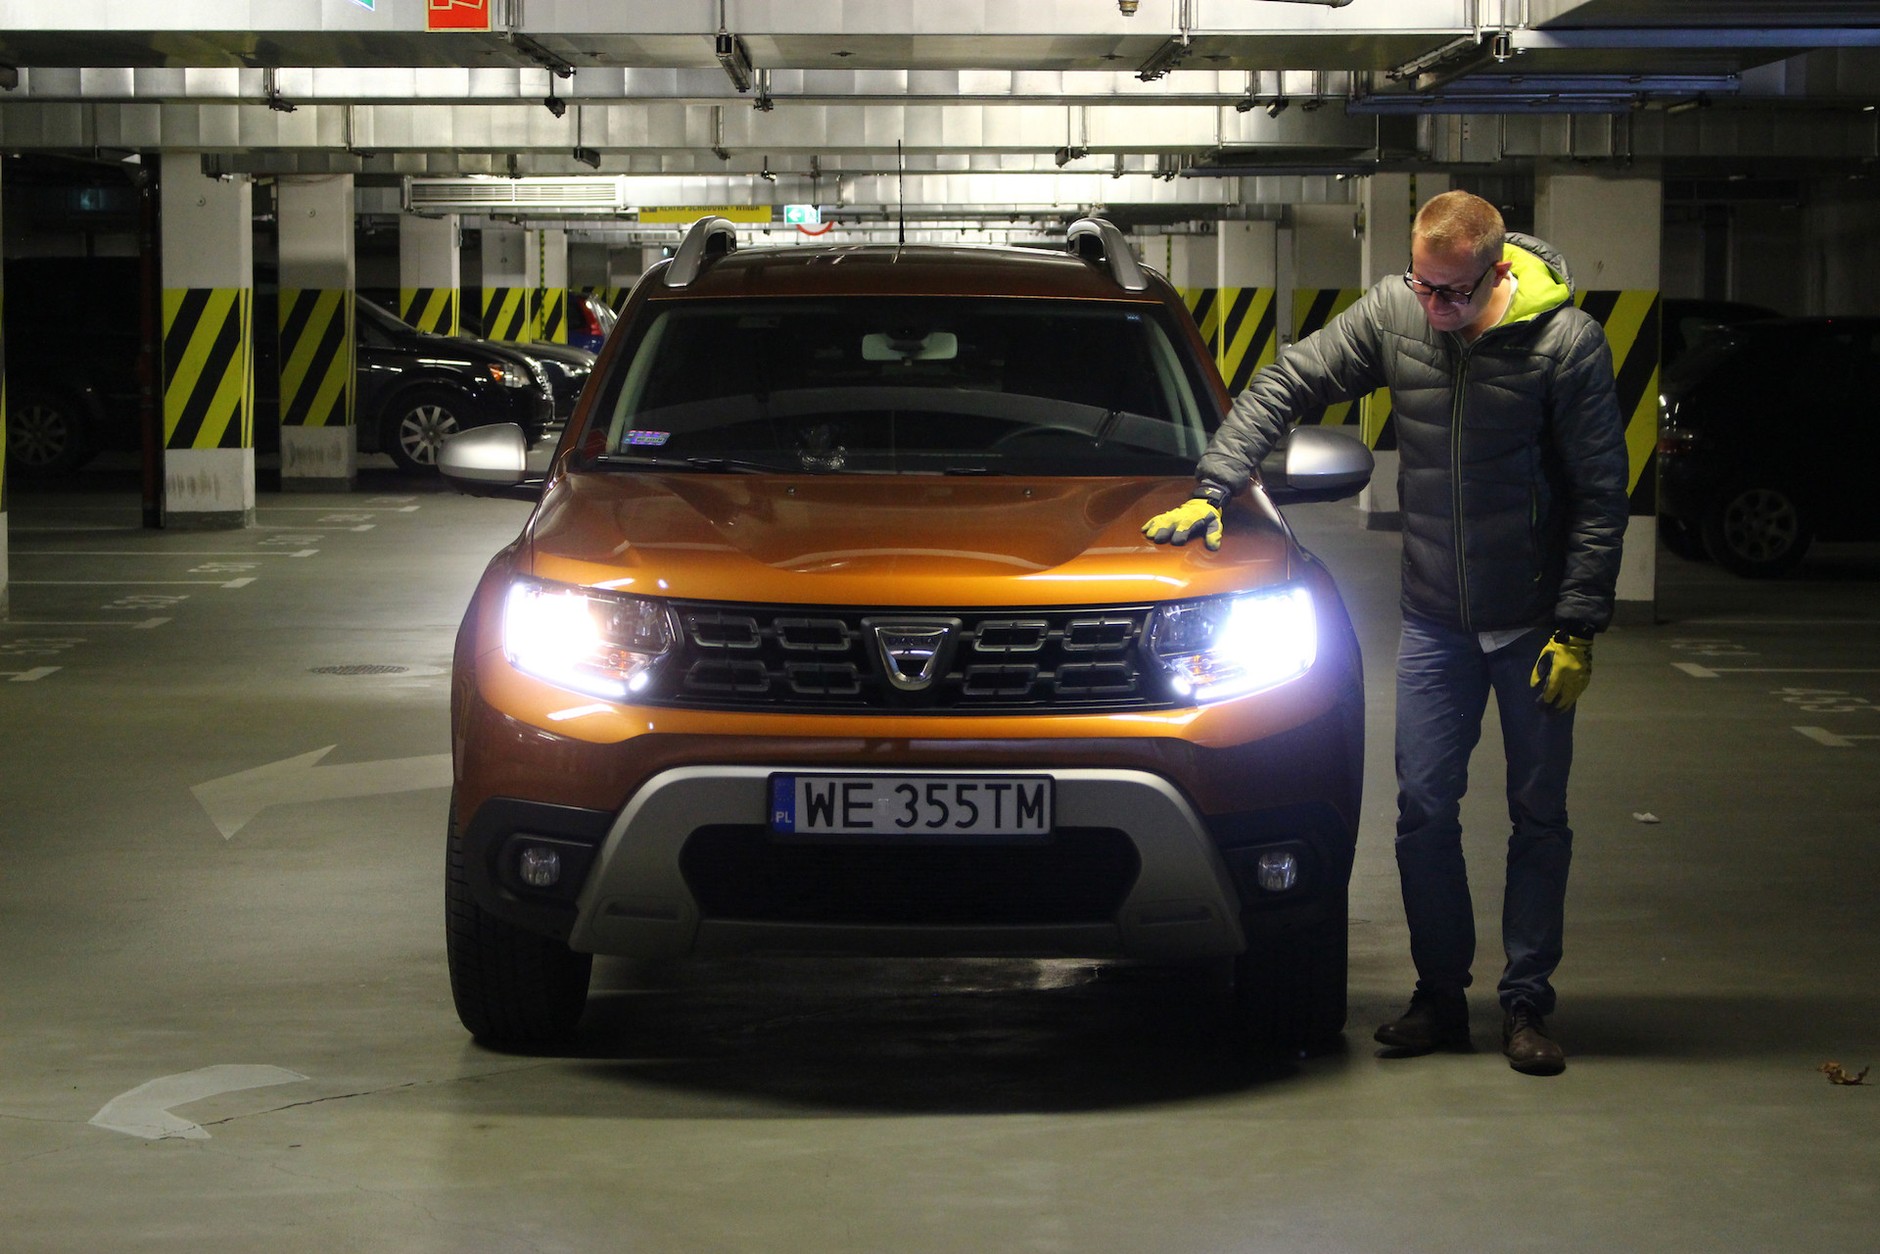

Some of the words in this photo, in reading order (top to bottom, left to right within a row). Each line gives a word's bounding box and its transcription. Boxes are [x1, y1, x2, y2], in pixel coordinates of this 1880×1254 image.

[775, 811, 792, 824] PL
[805, 782, 873, 828] WE
[894, 783, 1044, 829] 355TM
